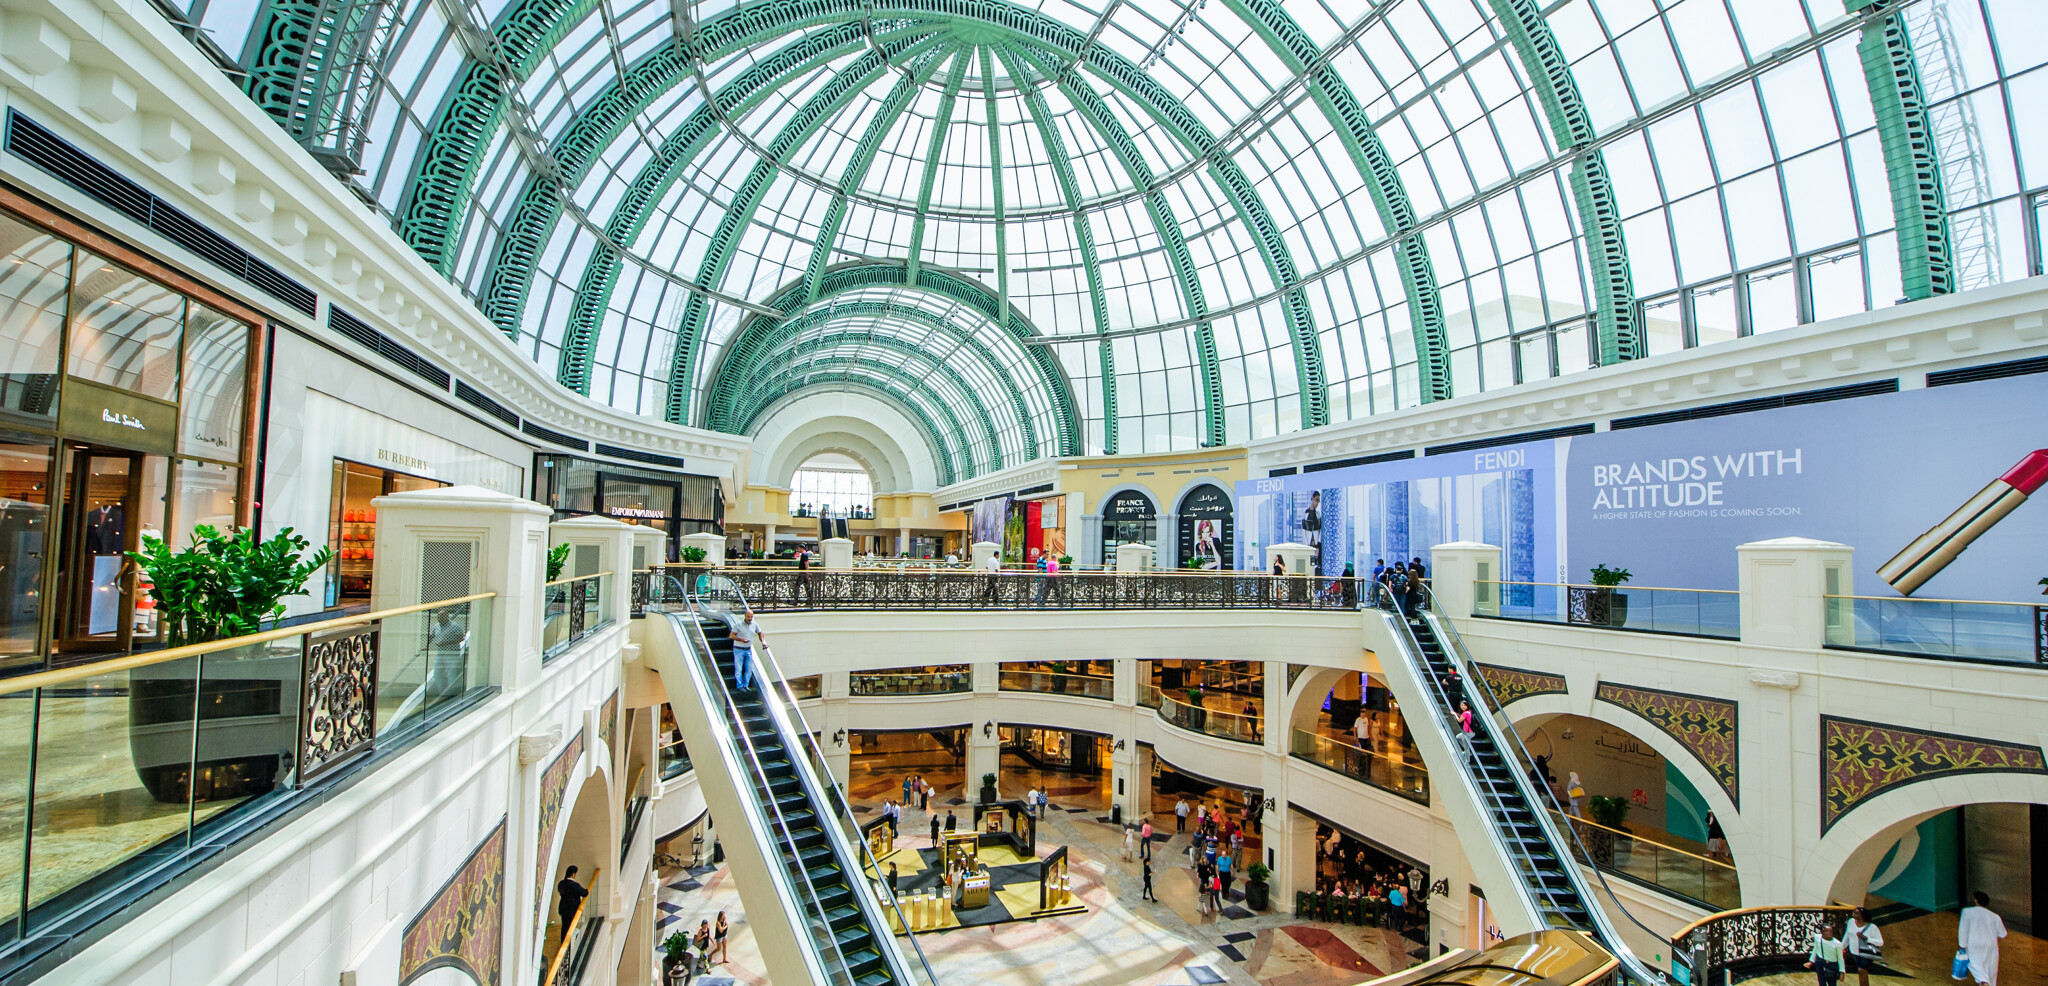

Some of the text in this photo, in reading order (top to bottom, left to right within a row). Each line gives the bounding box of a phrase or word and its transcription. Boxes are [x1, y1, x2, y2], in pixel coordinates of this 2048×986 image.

[102, 408, 145, 430] Paul Smith
[378, 448, 428, 470] BURBERRY
[1474, 449, 1525, 471] FENDI
[1594, 448, 1802, 486] BRANDS WITH
[1256, 478, 1284, 492] FENDI
[1592, 481, 1724, 510] ALTITUDE
[611, 506, 664, 519] EMPORIO ARMANI
[1117, 499, 1144, 507] FRANCK
[1600, 511, 1628, 520] HIGHER
[1629, 511, 1652, 519] STATE
[1654, 510, 1667, 518] OF
[1668, 509, 1708, 518] FASHION
[1710, 509, 1718, 517] IS
[1720, 507, 1764, 517] COMING
[1767, 506, 1803, 517] SOON.
